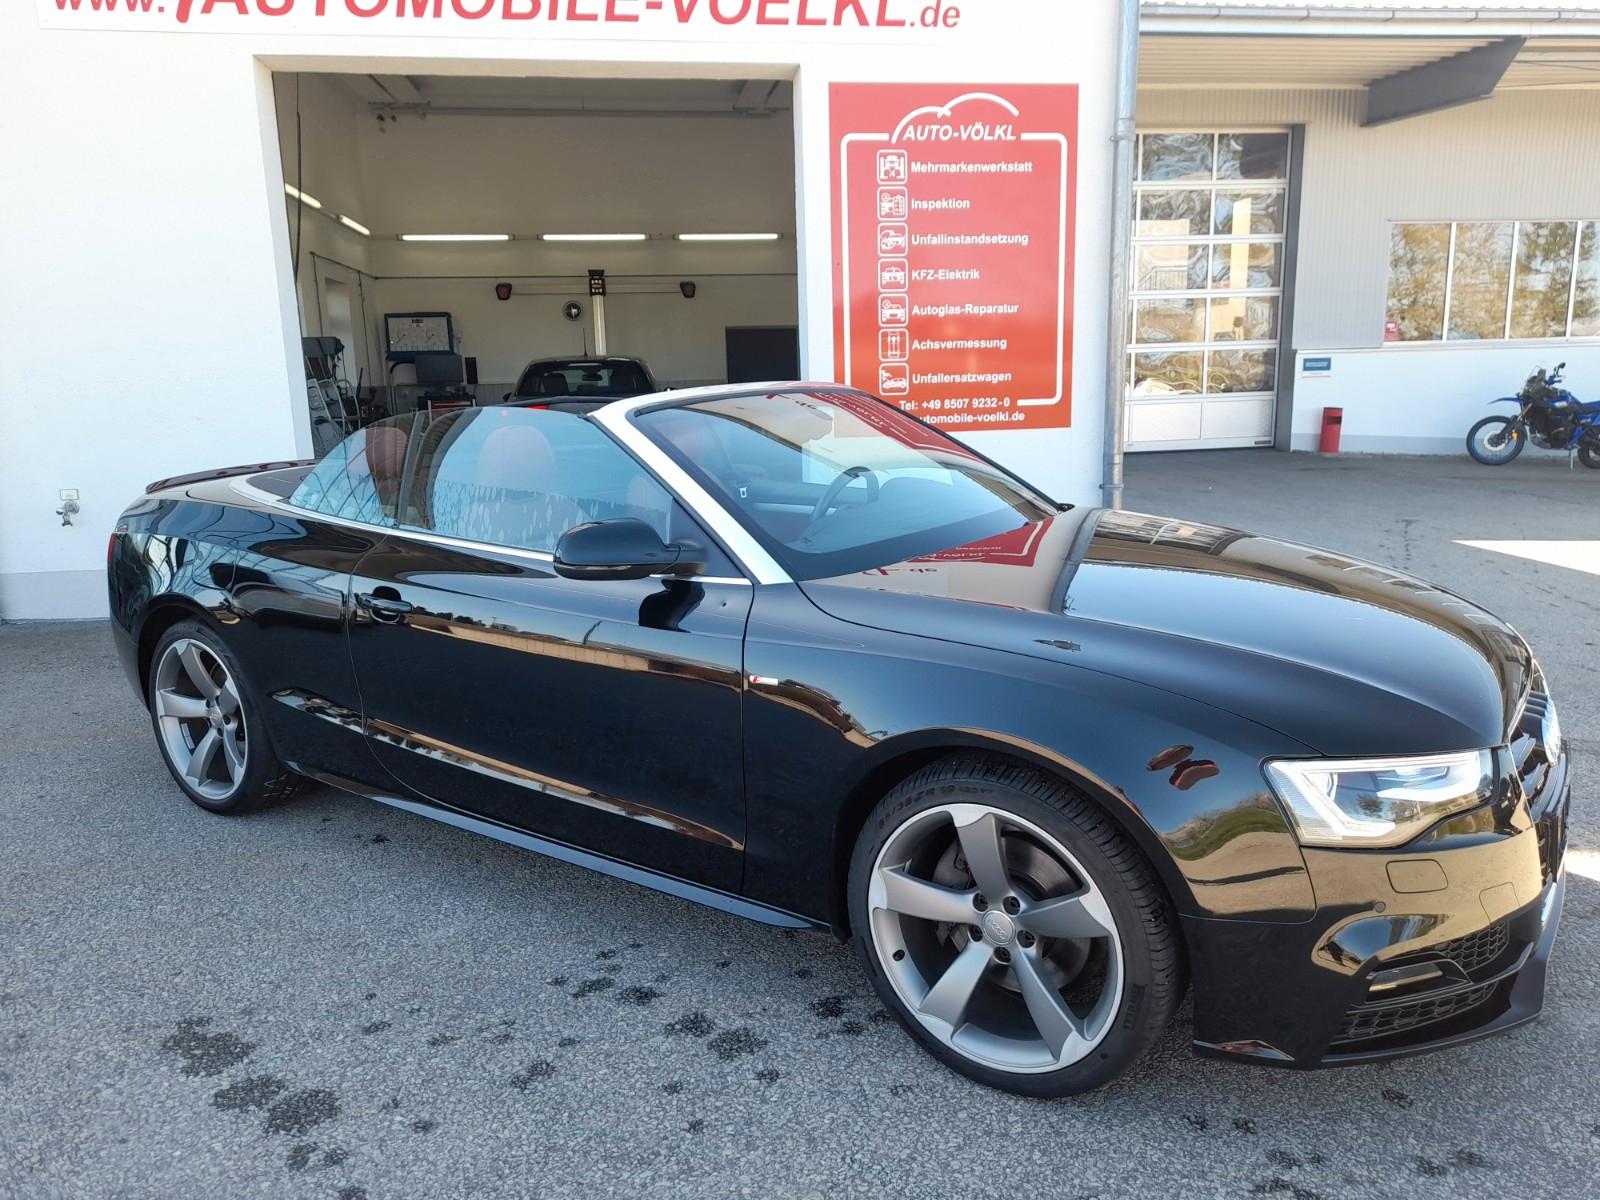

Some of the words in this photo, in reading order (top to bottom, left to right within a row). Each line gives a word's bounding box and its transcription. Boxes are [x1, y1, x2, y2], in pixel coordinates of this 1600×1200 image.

[902, 122, 1017, 141] AUTO-VÖLKL
[910, 161, 1033, 173] Mehrmarkenwerkstatt
[911, 198, 970, 211] Inspektion
[911, 233, 1029, 246] Unfallinstandsetzung
[911, 269, 980, 280] KFZ-Elektrik
[911, 303, 1020, 317] Autoglas-Reparatur
[911, 339, 1008, 350] Achsvermessung
[912, 372, 1012, 384] Unfallersatzwagen
[899, 400, 918, 411] Tel:
[921, 399, 942, 409] +49
[943, 398, 970, 409] 8507
